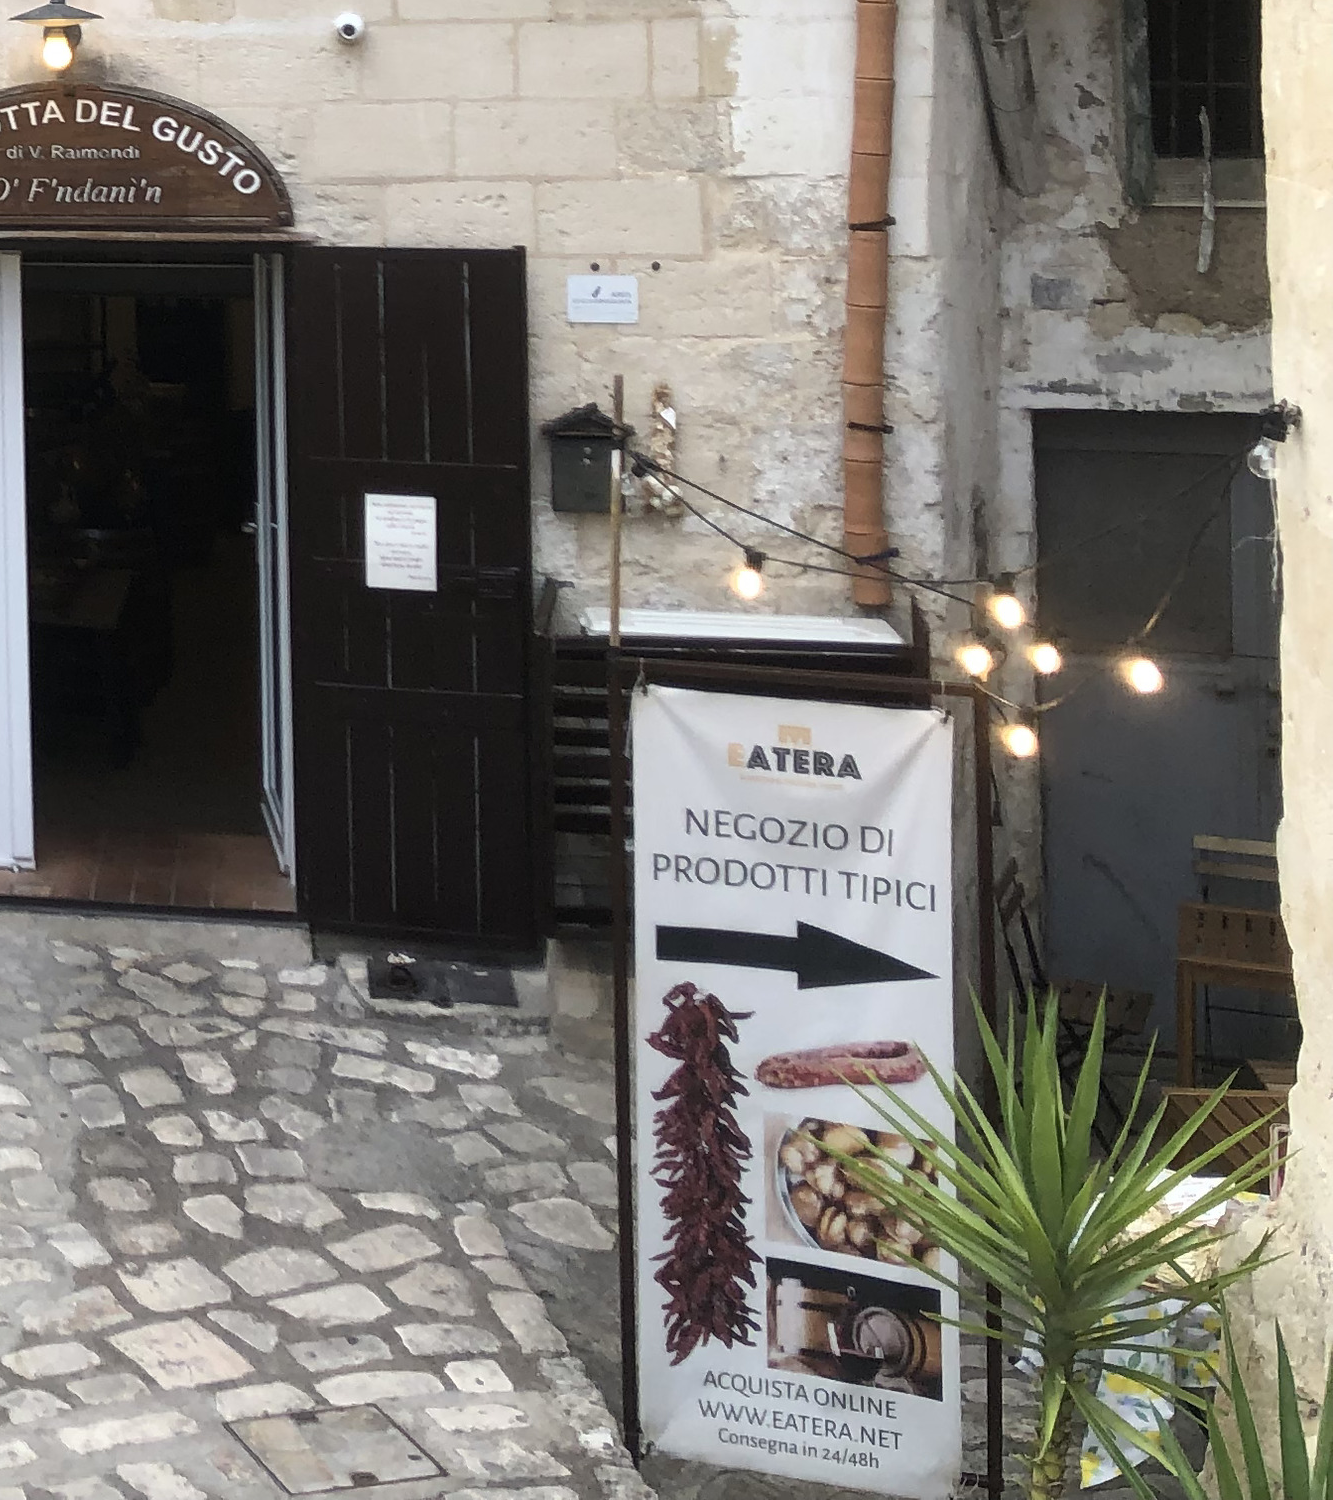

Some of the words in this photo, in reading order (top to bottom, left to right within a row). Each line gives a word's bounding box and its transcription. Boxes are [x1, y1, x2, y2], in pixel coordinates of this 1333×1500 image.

[6, 145, 24, 159] di
[28, 146, 44, 159] V.
[51, 144, 140, 159] Raimondi
[75, 99, 141, 132] DEL
[152, 116, 262, 195] GUSTO
[727, 742, 863, 780] EATERA
[685, 807, 849, 851] NEGOZIO
[859, 825, 893, 857] DI
[652, 852, 828, 897] PRODOTTI
[837, 870, 936, 912] TIPICI
[703, 1370, 809, 1403] ACQUISTA
[813, 1387, 897, 1419] ONLINE
[698, 1399, 903, 1450] WWW.EATERA.NET
[718, 1428, 798, 1455] Consegna
[802, 1440, 818, 1458] in
[822, 1448, 880, 1469] 24/48h
